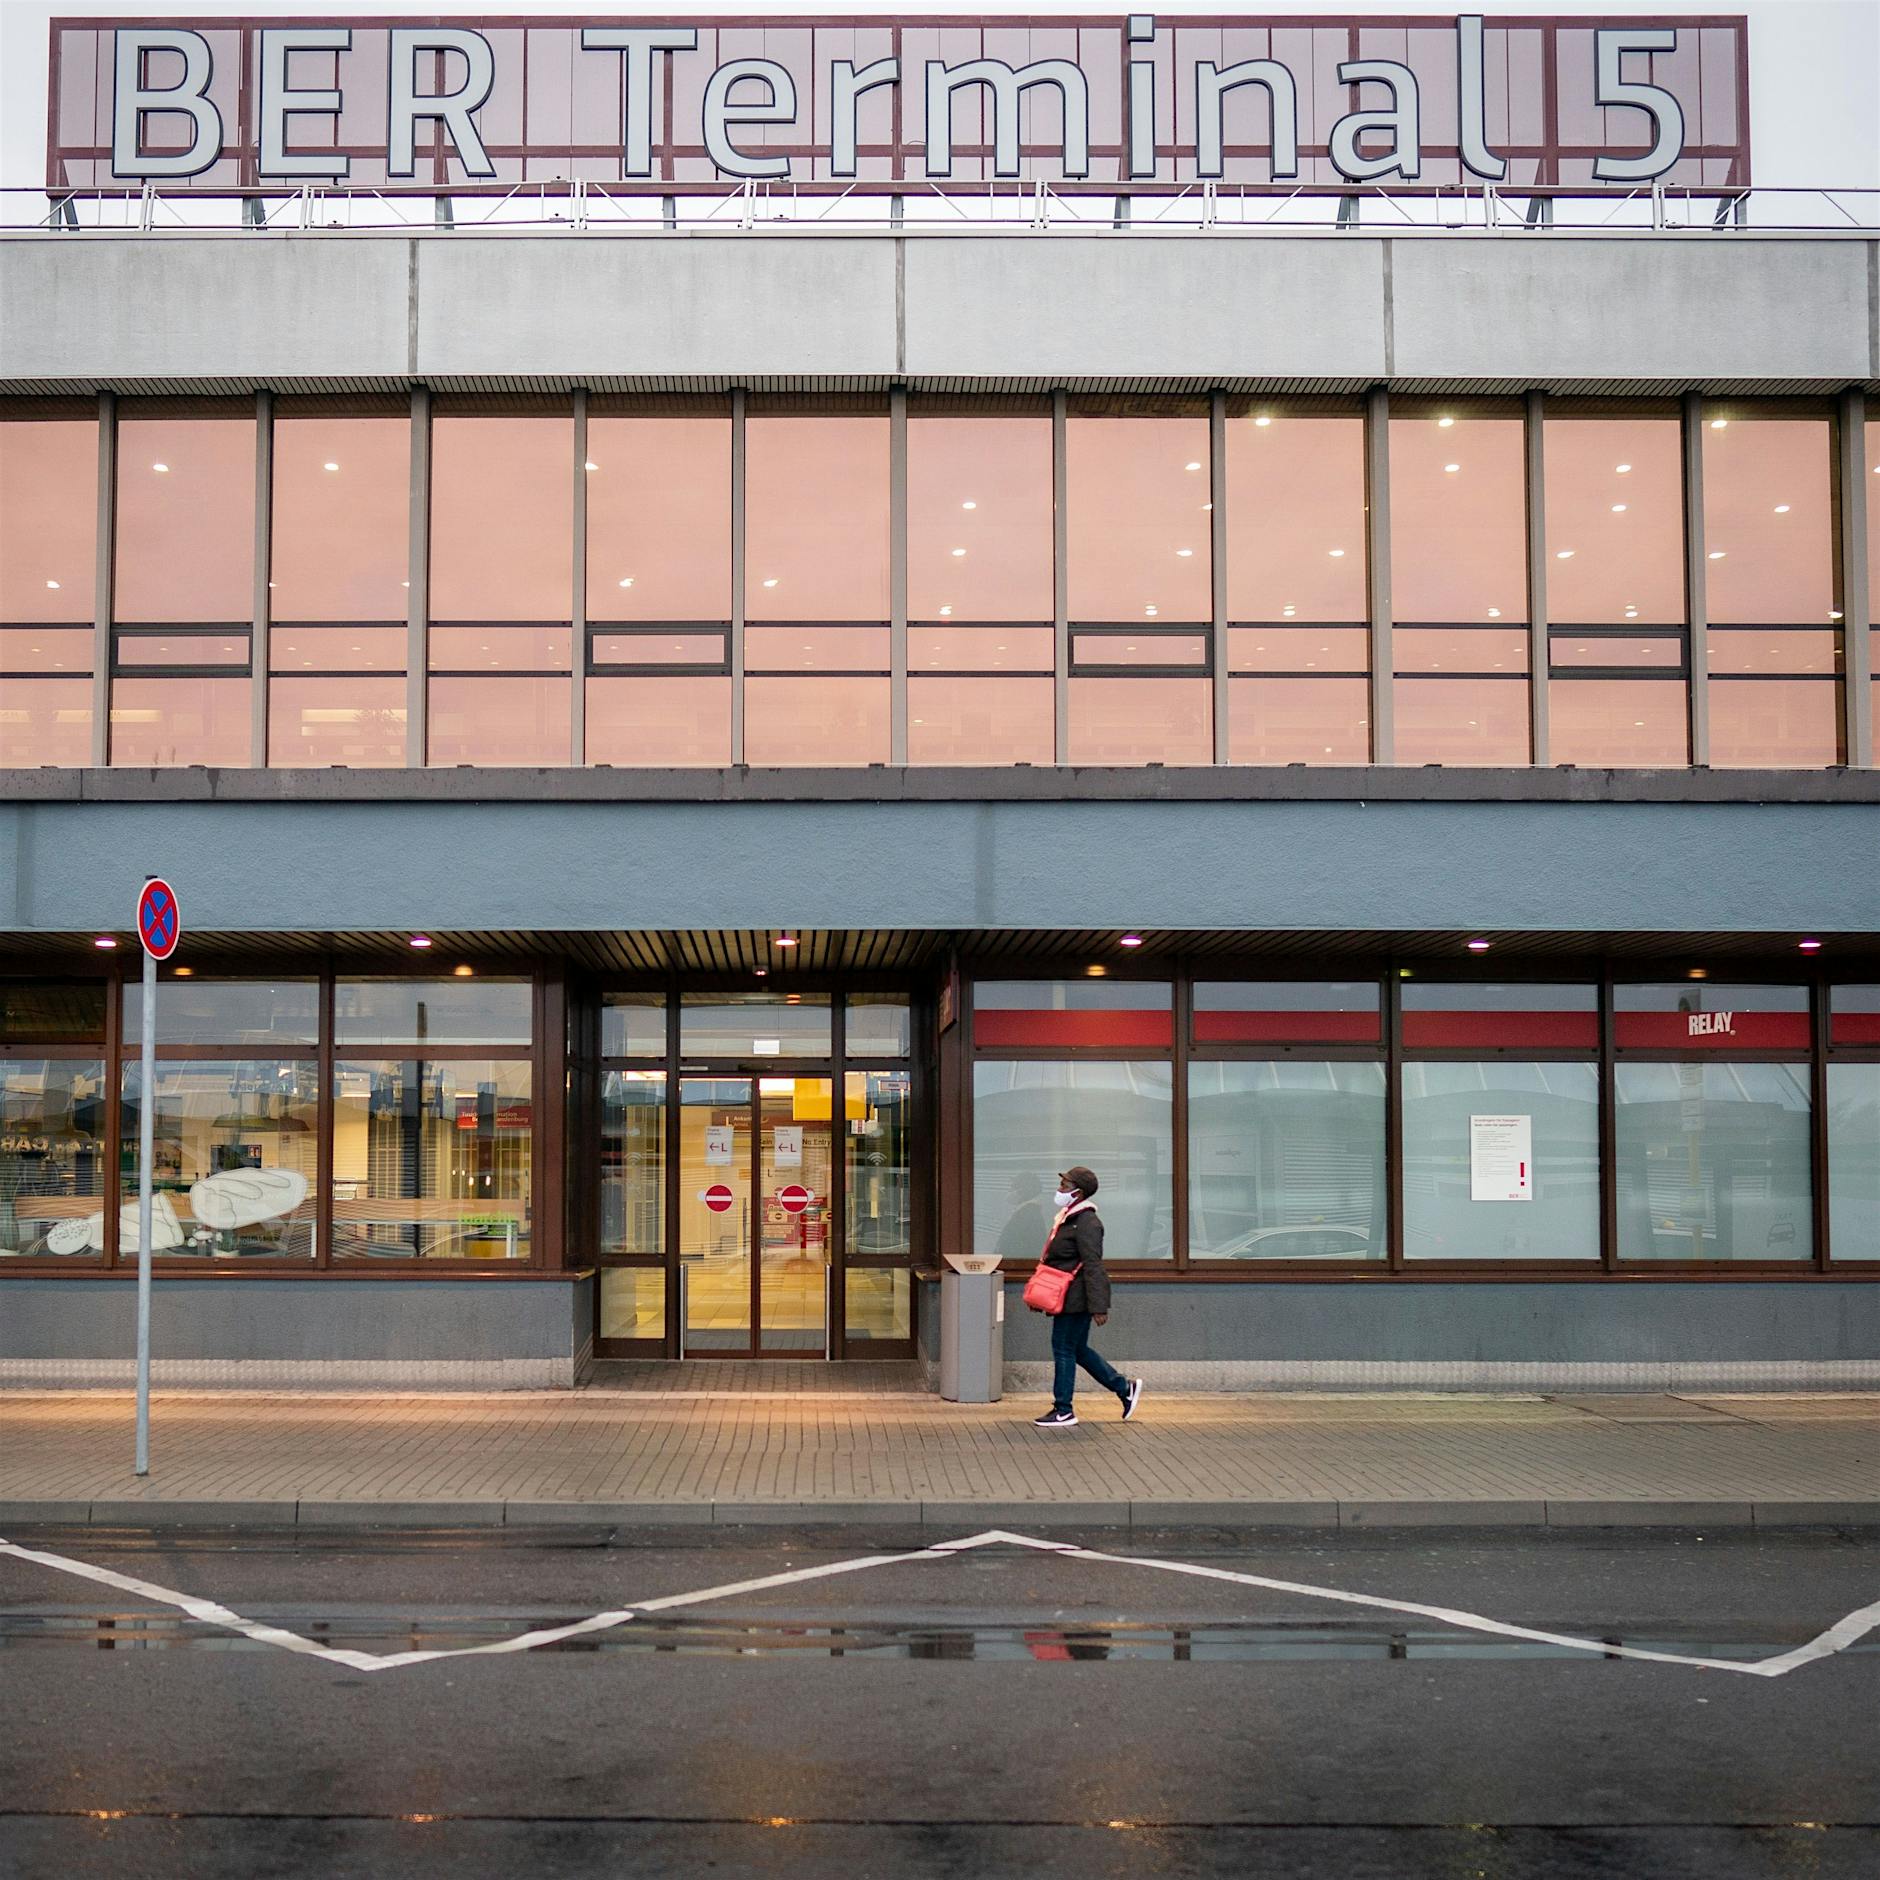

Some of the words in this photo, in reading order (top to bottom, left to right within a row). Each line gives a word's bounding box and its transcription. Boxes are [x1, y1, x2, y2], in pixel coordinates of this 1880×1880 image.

[111, 28, 497, 179] BER
[581, 14, 1506, 181] Terminal
[1592, 28, 1685, 181] 5
[721, 1143, 728, 1152] L
[790, 1143, 797, 1152] L
